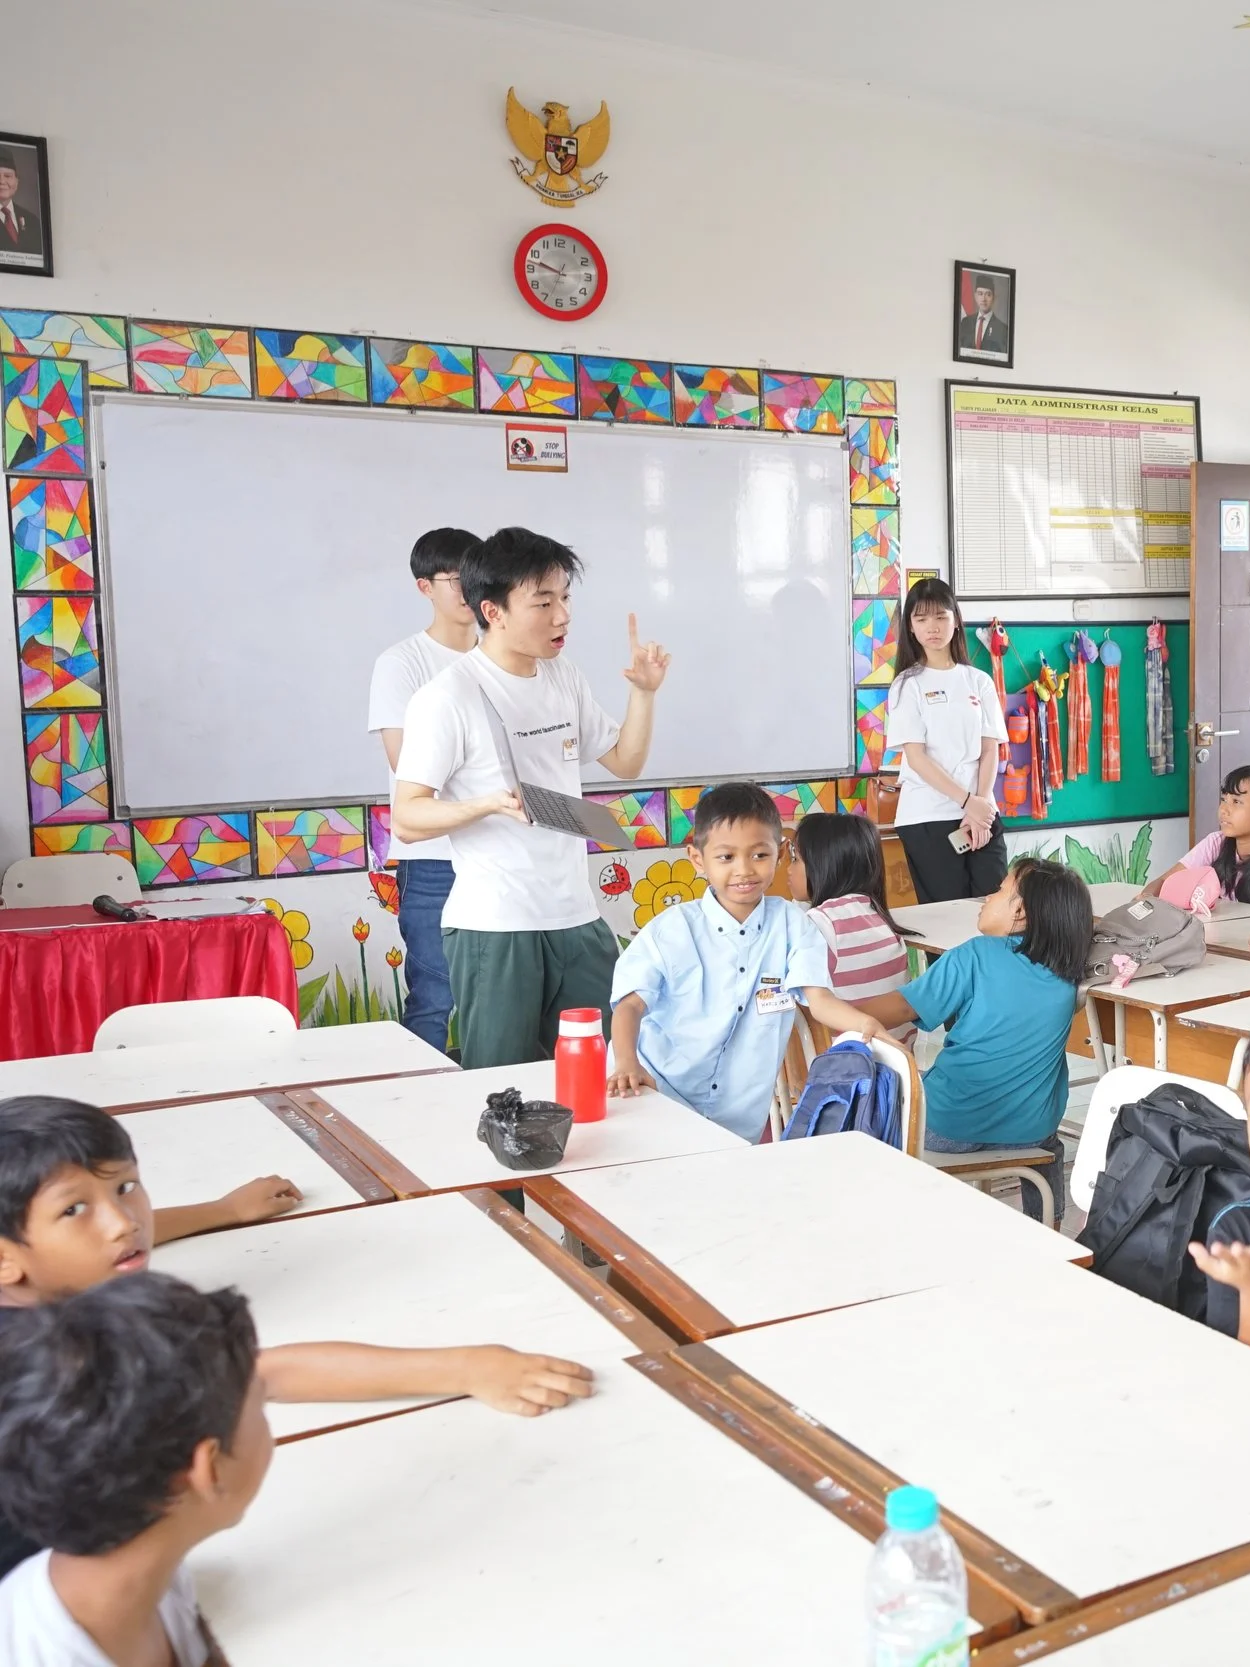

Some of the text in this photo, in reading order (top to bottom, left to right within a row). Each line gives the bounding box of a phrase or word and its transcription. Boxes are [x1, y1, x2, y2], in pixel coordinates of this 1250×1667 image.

[542, 240, 549, 250] 11
[554, 238, 566, 249] 12
[530, 249, 540, 259] 10
[580, 257, 589, 267] 2
[526, 264, 535, 273] 9
[584, 272, 592, 282] 3
[531, 280, 539, 290] 8
[541, 292, 549, 302] 7
[578, 287, 588, 297] 4
[555, 298, 564, 308] 6
[569, 296, 578, 306] 5
[997, 397, 1159, 415] DATA ADMINISTRASI KELAS
[541, 451, 565, 459] BULLYING
